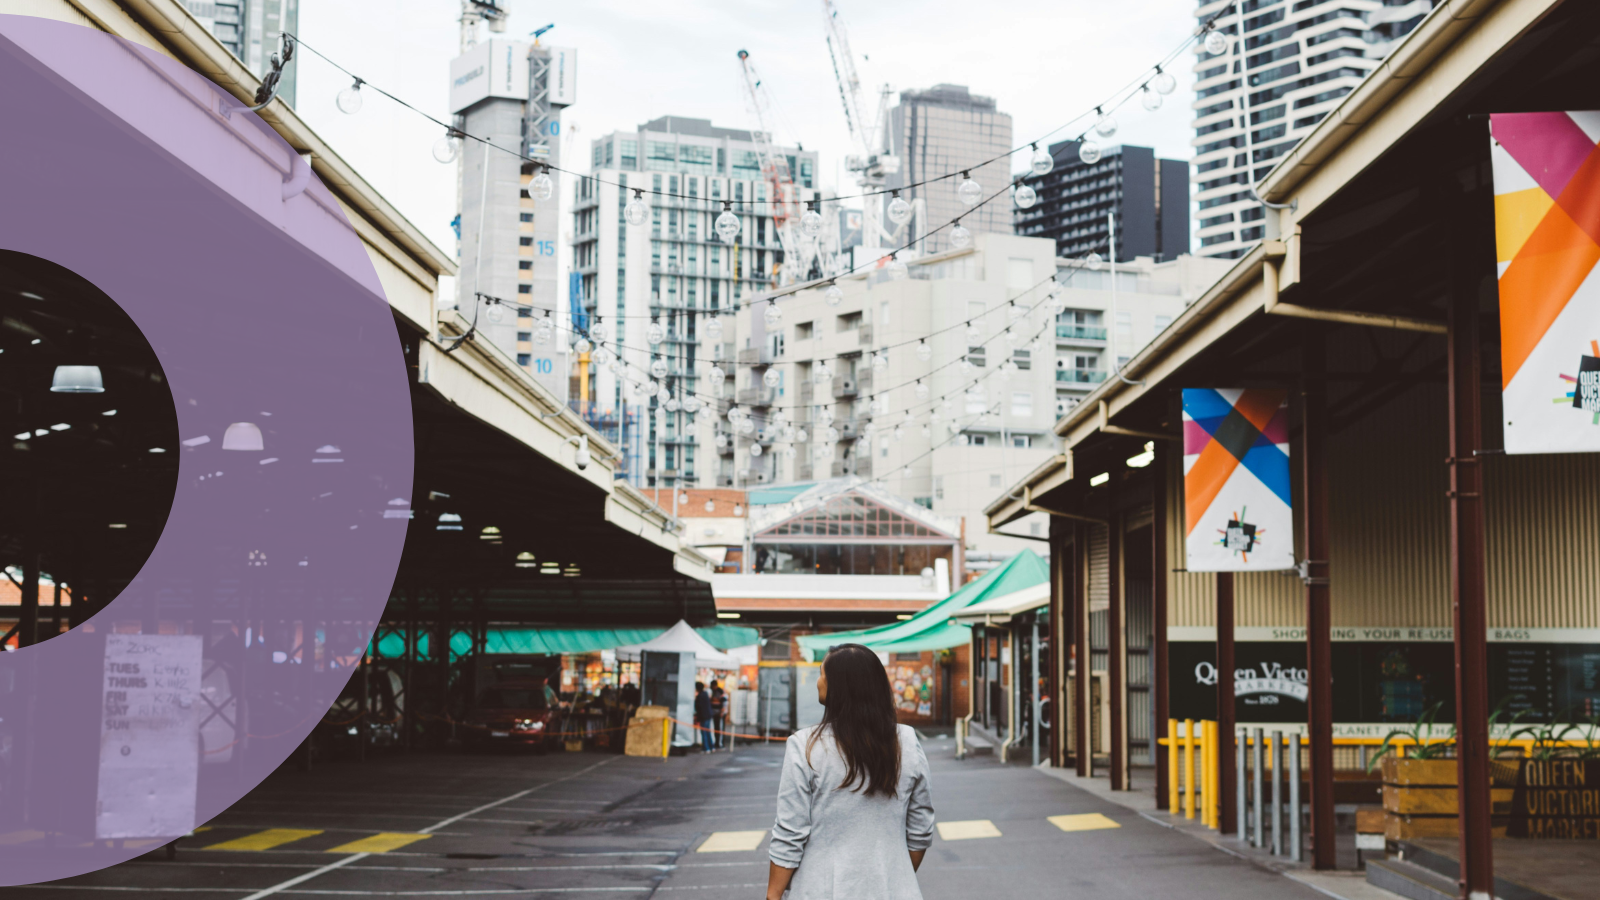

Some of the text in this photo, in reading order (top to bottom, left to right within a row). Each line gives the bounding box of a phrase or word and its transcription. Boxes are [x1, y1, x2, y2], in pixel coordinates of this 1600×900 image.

[537, 241, 554, 256] 15
[535, 358, 552, 374] 10
[1580, 370, 1600, 386] QUE
[1580, 384, 1600, 399] VIC
[1363, 629, 1401, 639] YOUR
[1495, 630, 1531, 640] BAGS
[110, 662, 140, 674] TUES
[1195, 661, 1308, 685] Qen Victo
[108, 676, 147, 688] THURS
[107, 691, 127, 702] FRI
[105, 719, 130, 730] SUN
[1525, 760, 1585, 786] QUEEN
